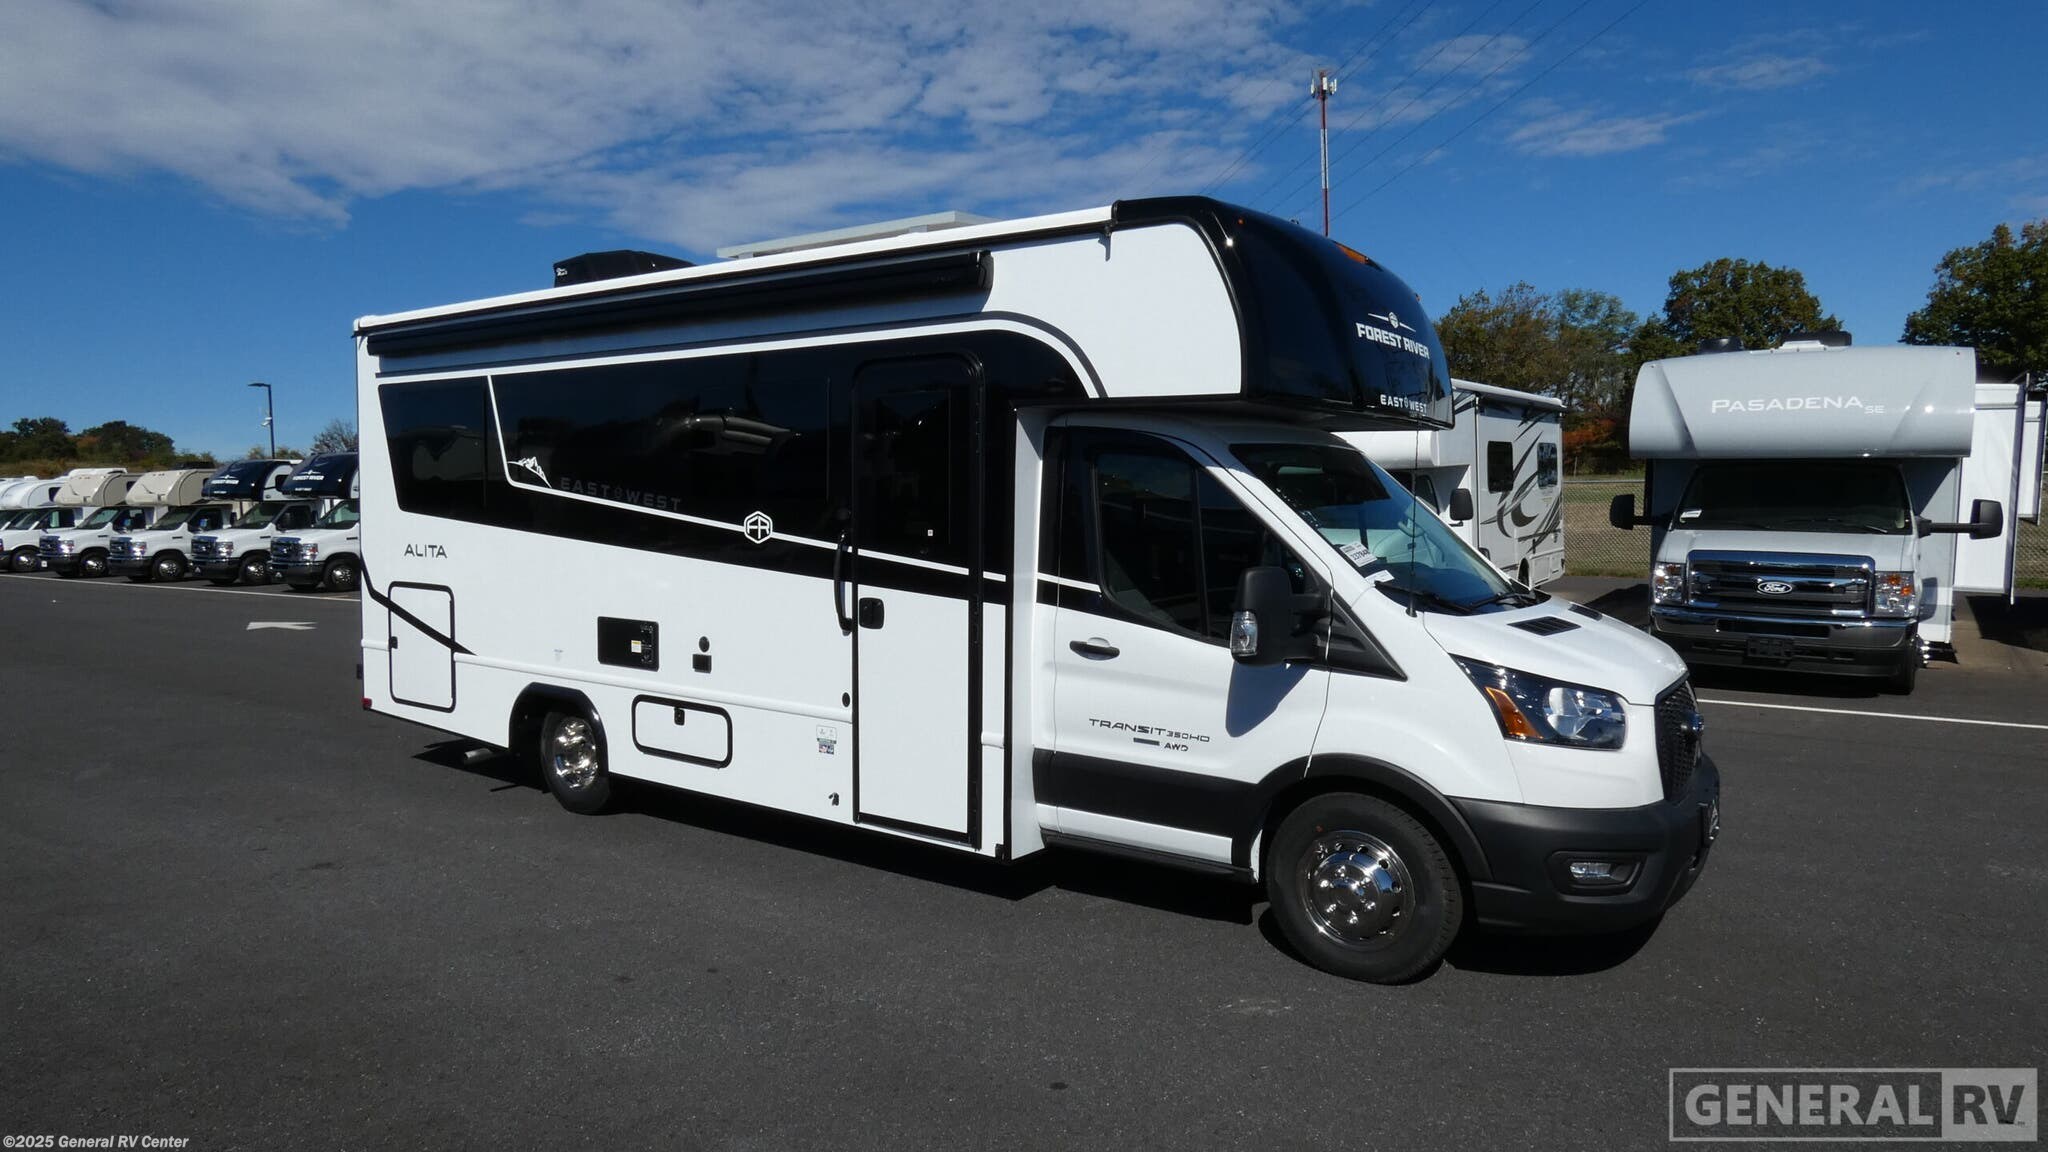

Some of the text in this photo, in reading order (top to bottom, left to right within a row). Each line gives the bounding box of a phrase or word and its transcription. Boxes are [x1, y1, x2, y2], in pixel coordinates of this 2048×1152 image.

[1356, 322, 1431, 360] FOREST RIVER
[1380, 394, 1427, 414] EAST WEST
[1711, 396, 1885, 414] PASADENA SE
[561, 477, 681, 511] EAST WEST
[404, 543, 448, 559] ALITA
[1164, 742, 1189, 752] AWD
